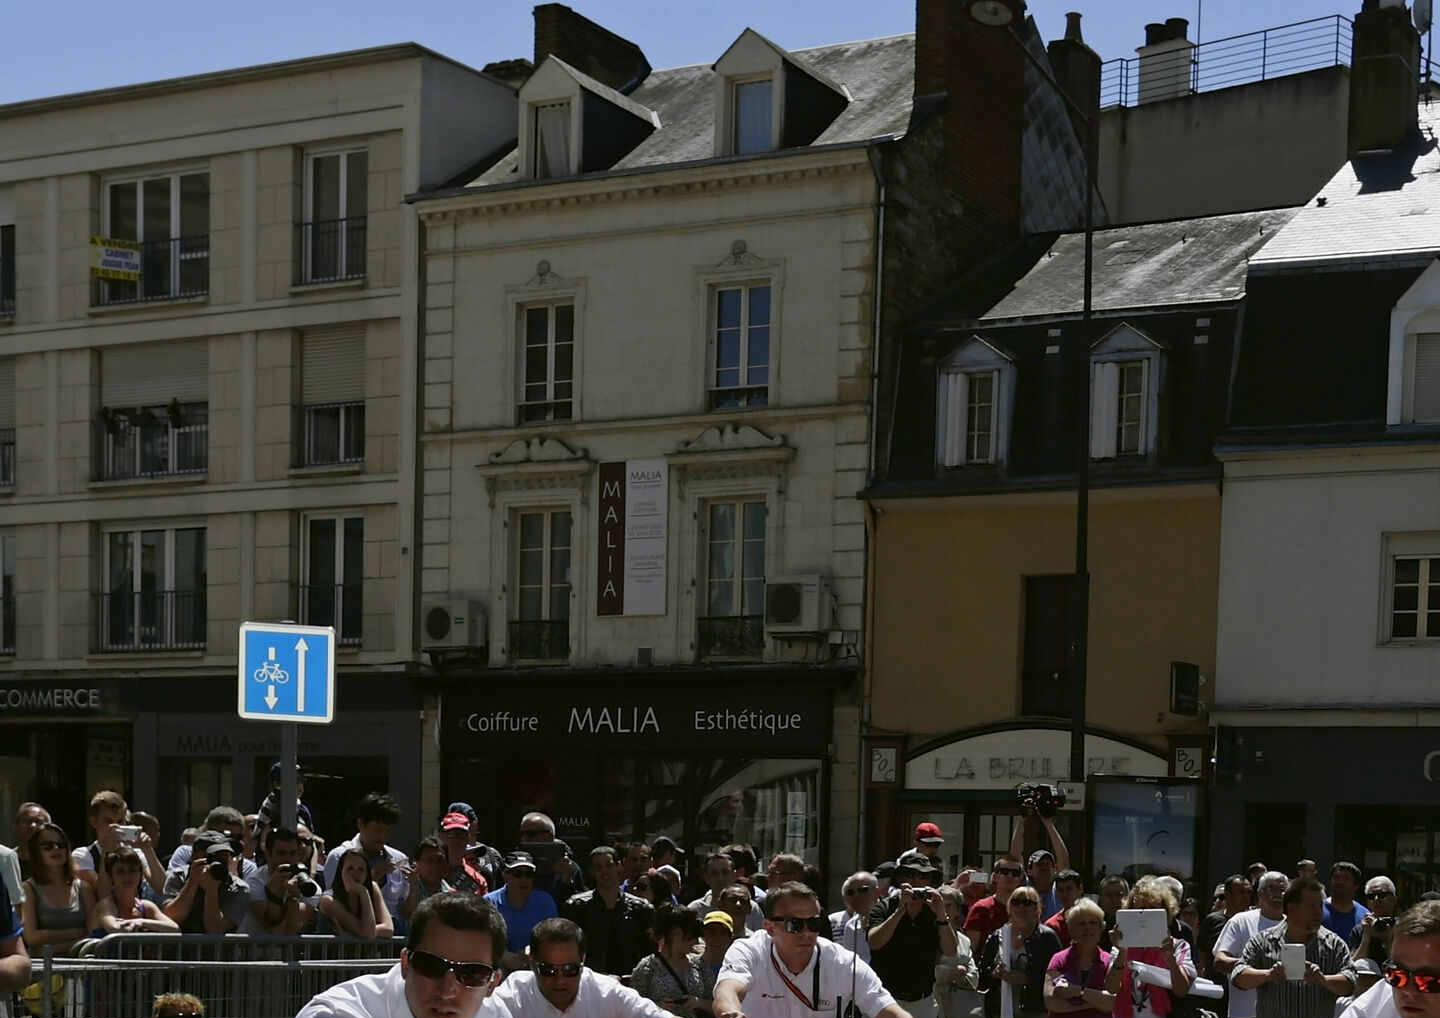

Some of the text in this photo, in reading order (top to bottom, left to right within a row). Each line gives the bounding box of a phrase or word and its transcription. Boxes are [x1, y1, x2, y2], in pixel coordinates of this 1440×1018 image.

[630, 470, 662, 480] MALIA
[602, 480, 621, 597] MALIA
[0, 688, 99, 709] COMMERCE
[466, 711, 539, 732] Coiffure
[567, 706, 661, 734] MALIA
[694, 708, 802, 735] Esthétique
[176, 735, 231, 753] MALIA
[934, 757, 976, 779] LA
[558, 816, 591, 827] MALIA
